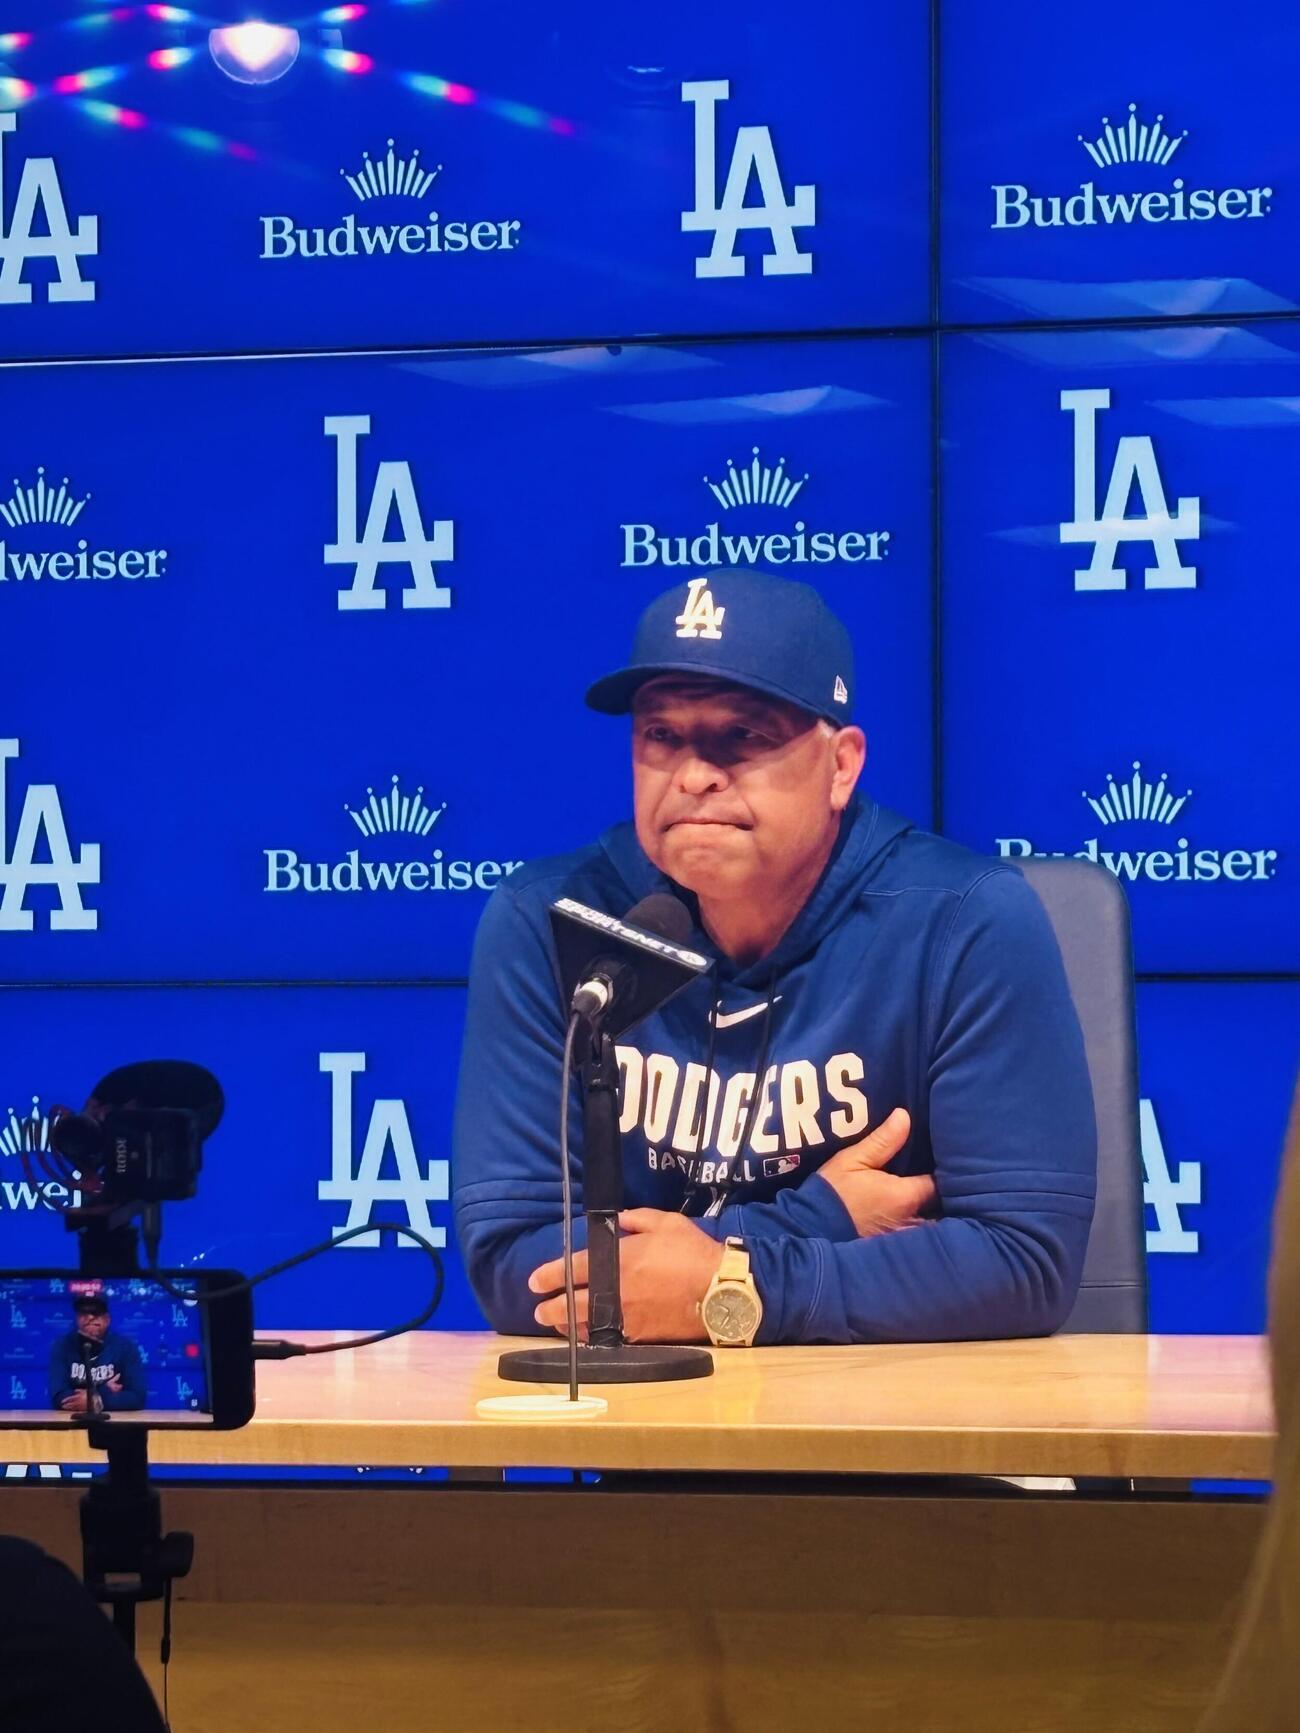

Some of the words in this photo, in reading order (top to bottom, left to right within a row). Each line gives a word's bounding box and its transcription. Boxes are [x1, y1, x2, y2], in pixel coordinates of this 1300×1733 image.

[681, 79, 816, 278] LA
[991, 178, 1273, 230] Budweiser
[259, 211, 521, 258] Budweiser
[324, 415, 454, 610] LA
[1059, 388, 1200, 591] LA
[0, 538, 168, 582] weiser
[620, 521, 890, 568] Budweiser
[674, 577, 726, 641] LA
[615, 1045, 869, 1160] DODGERS
[318, 1052, 449, 1248] LA
